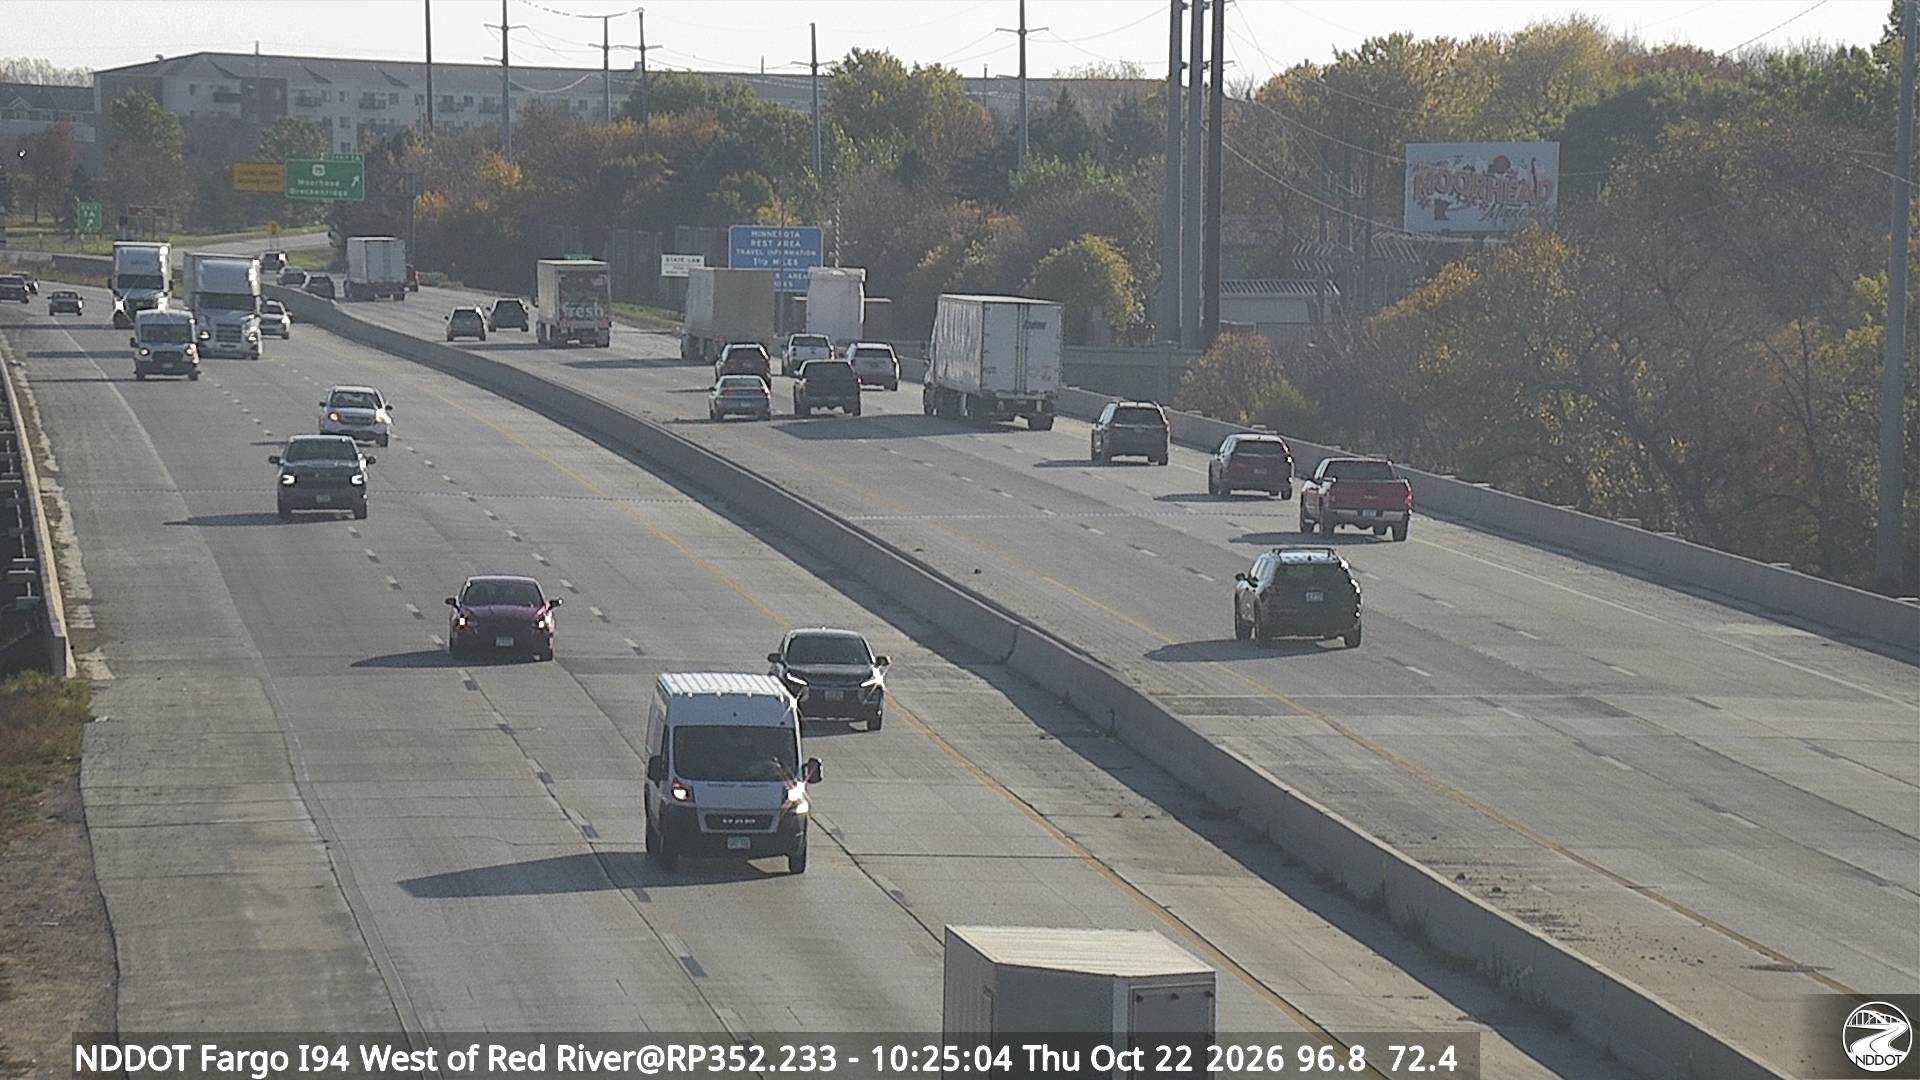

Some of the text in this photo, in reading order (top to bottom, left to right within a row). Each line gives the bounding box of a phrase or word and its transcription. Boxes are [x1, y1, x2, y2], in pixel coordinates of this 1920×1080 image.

[297, 178, 340, 187] Moorhead
[1413, 168, 1553, 206] MOORHEAD
[289, 187, 348, 197] Breckenridge
[750, 239, 801, 248] REST AREA
[736, 248, 764, 256] TRAVEL
[773, 258, 799, 267] MLES
